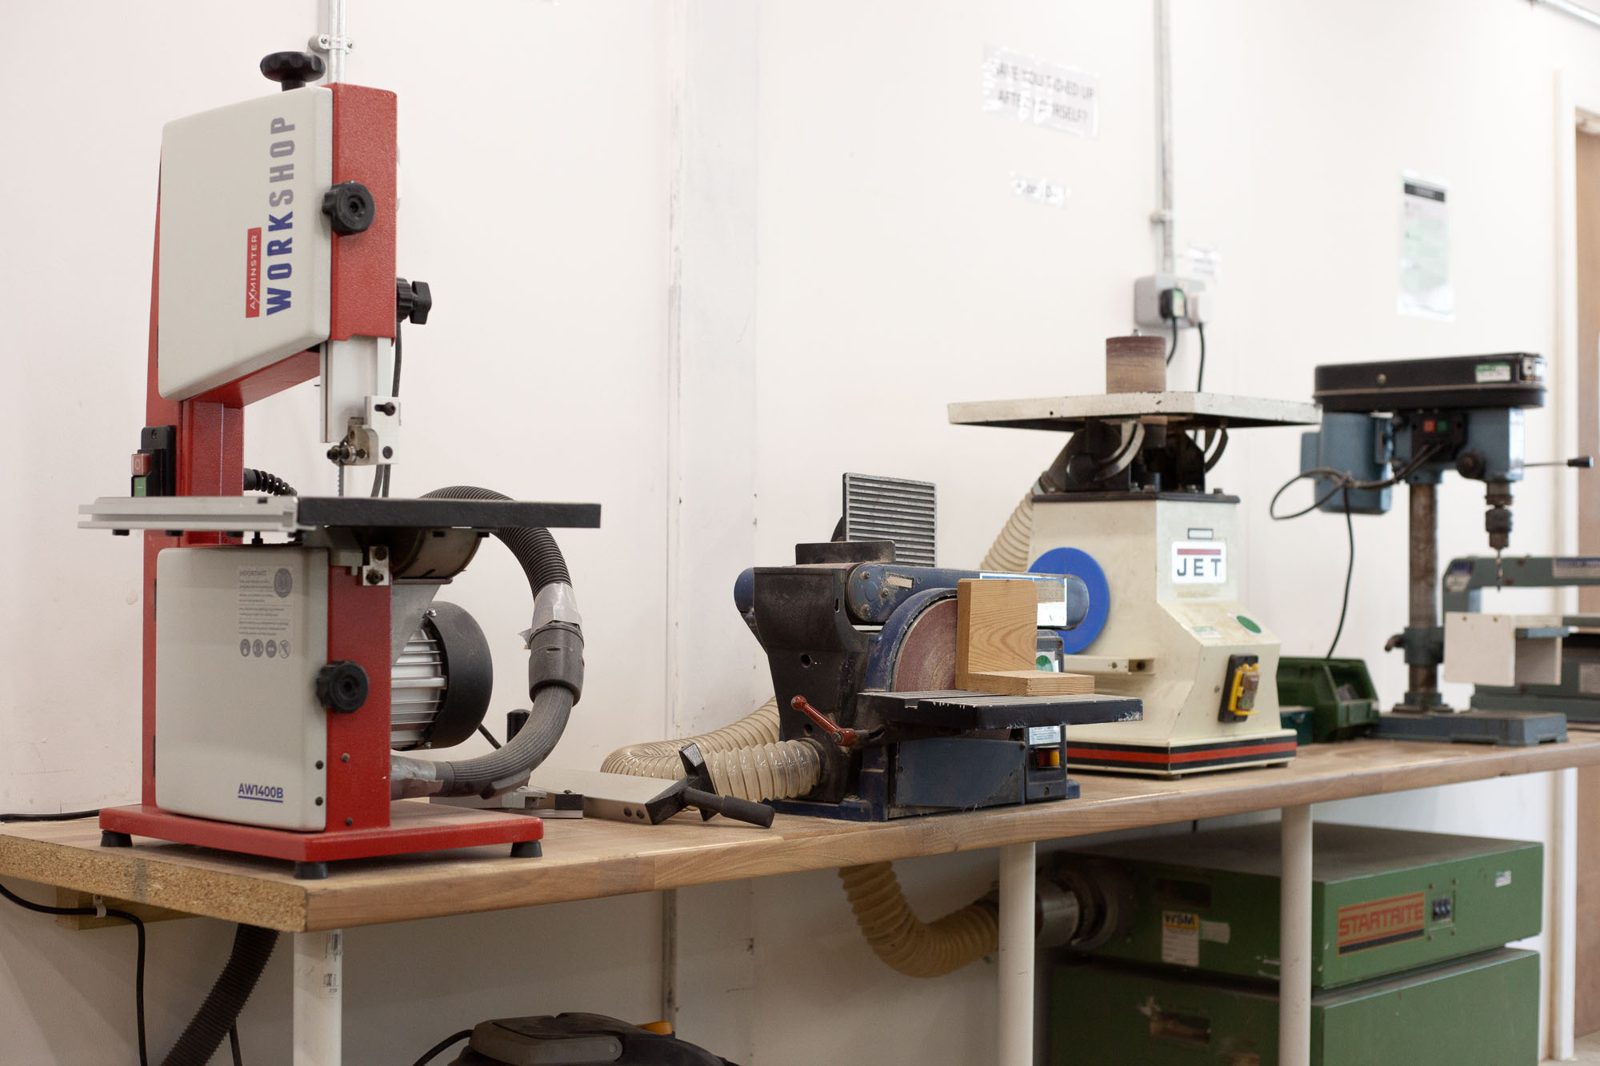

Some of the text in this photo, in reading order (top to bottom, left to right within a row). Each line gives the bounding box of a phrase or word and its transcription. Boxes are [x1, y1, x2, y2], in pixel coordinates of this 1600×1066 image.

[266, 117, 295, 316] WORKSHOP
[249, 234, 259, 311] AXMINSTER
[1176, 558, 1222, 577] JET
[238, 783, 284, 799] AW1400B
[1338, 903, 1424, 931] STARTRITE
